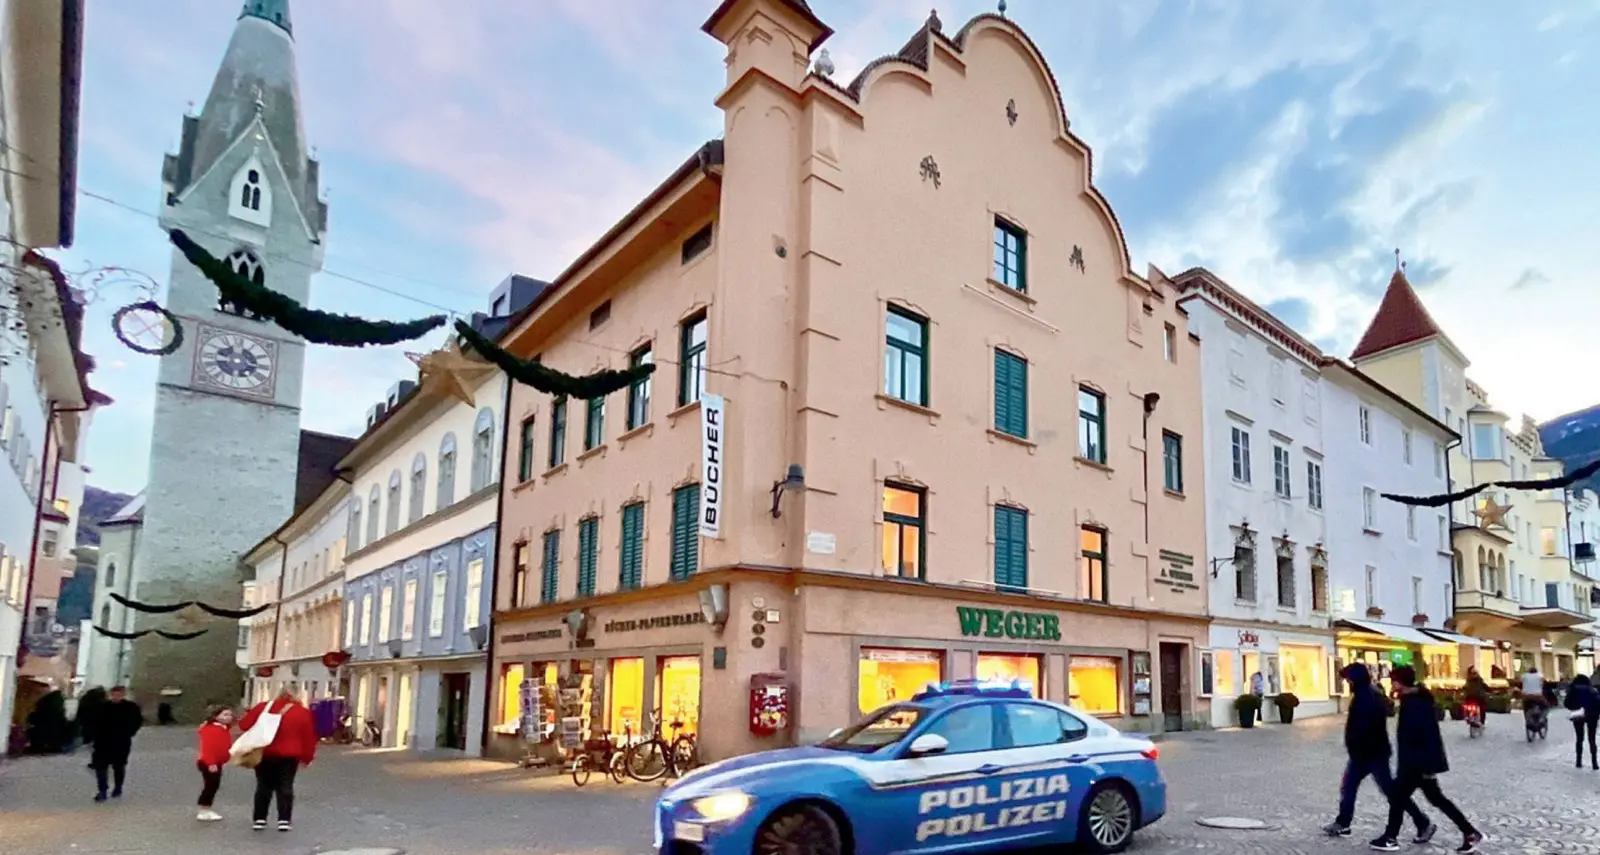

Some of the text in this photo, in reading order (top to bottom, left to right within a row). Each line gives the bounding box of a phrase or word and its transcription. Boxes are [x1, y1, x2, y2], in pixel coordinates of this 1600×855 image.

[704, 407, 719, 525] BÜCHER
[956, 606, 1062, 641] WEGER
[918, 773, 1071, 814] POLIZIA
[916, 800, 1067, 842] POLIZEI
